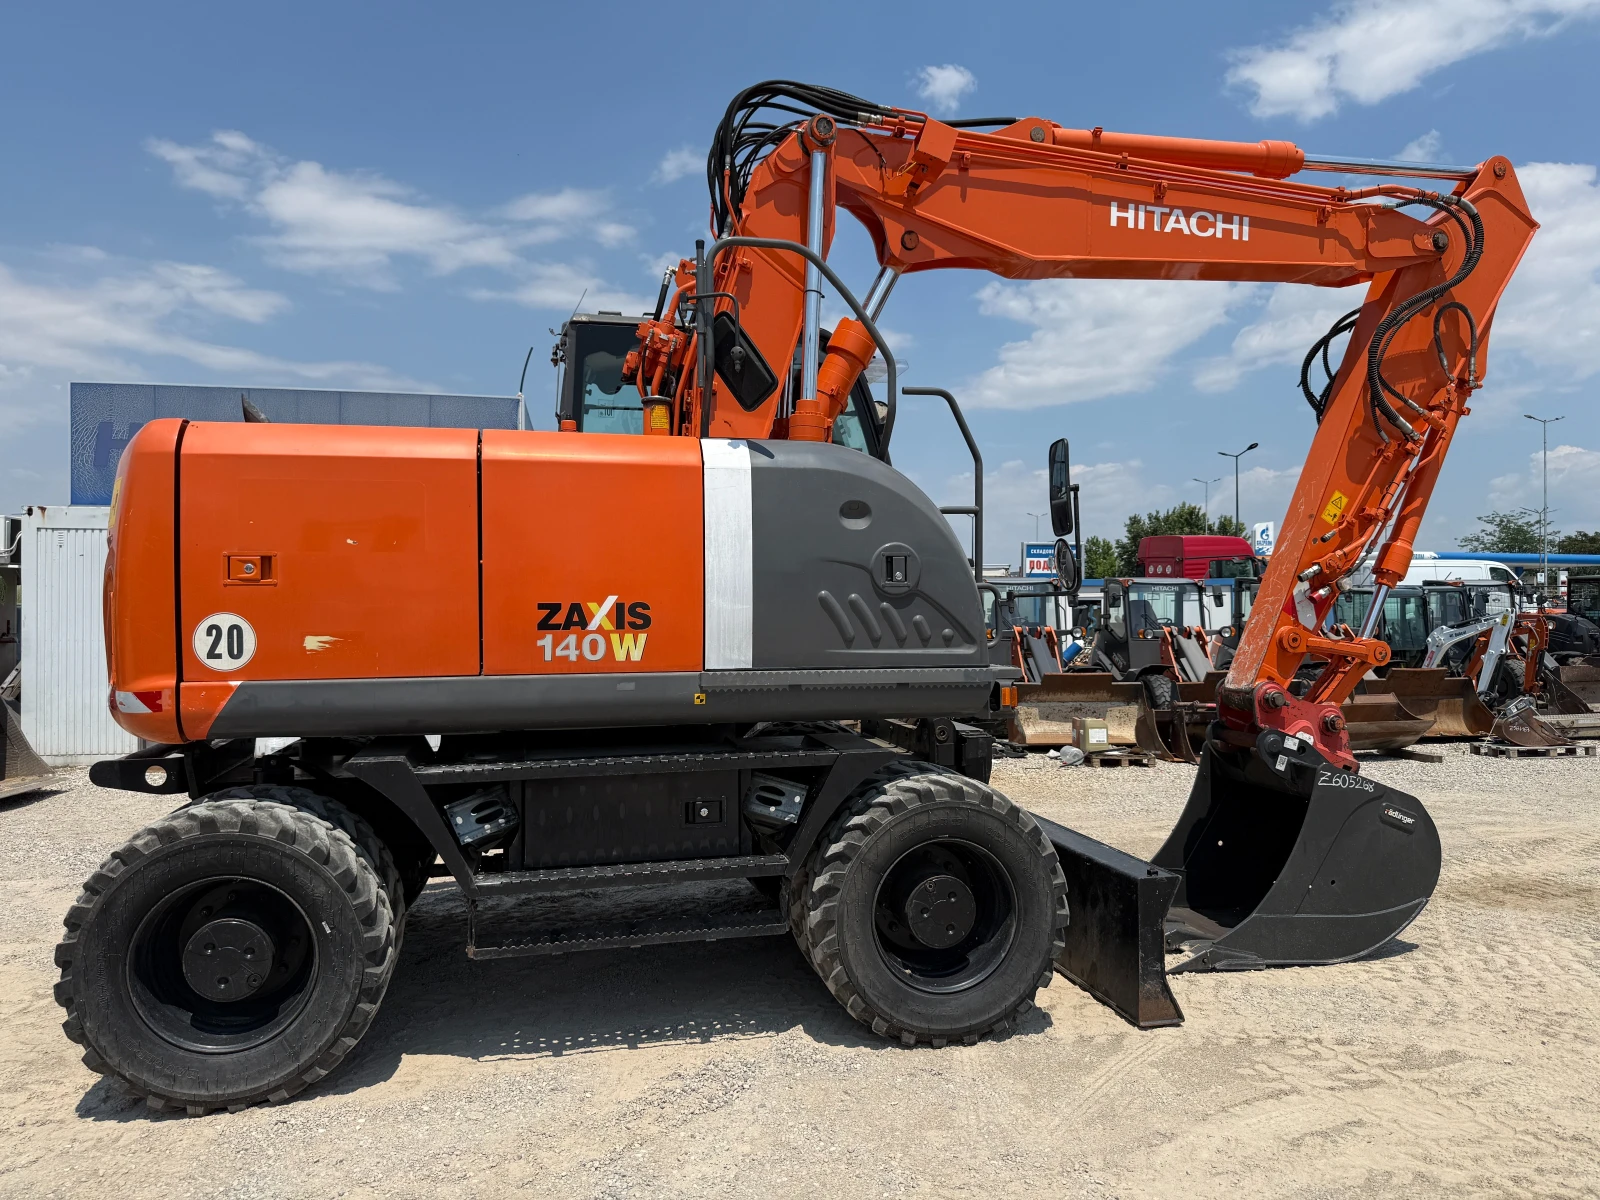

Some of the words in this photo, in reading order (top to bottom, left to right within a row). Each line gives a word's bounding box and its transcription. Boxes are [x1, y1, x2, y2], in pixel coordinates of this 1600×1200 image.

[1110, 201, 1250, 241] HITACHI
[537, 595, 652, 631] ZAXIS
[206, 623, 244, 660] 20
[536, 633, 648, 662] 140W
[1317, 770, 1375, 793] Z605268
